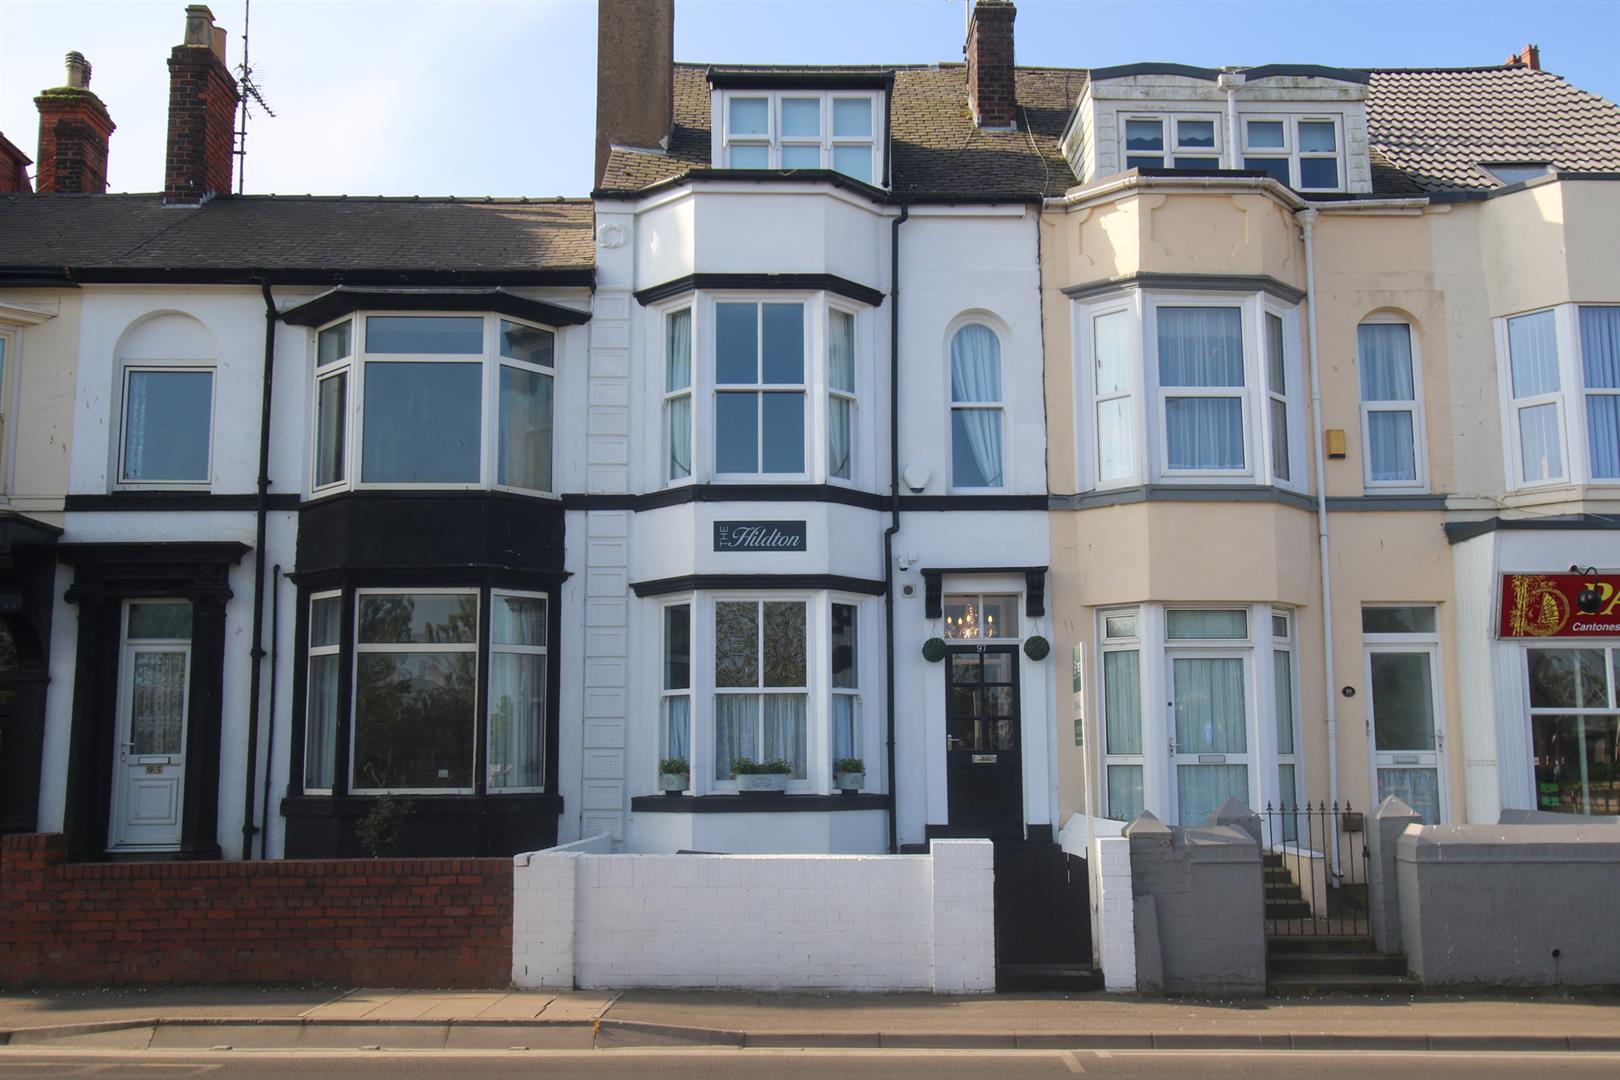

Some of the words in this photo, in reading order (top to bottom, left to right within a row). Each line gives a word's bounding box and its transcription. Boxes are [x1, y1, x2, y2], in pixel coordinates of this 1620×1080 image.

[719, 525, 729, 547] THE
[728, 526, 801, 547] Hildton
[976, 643, 987, 653] 97
